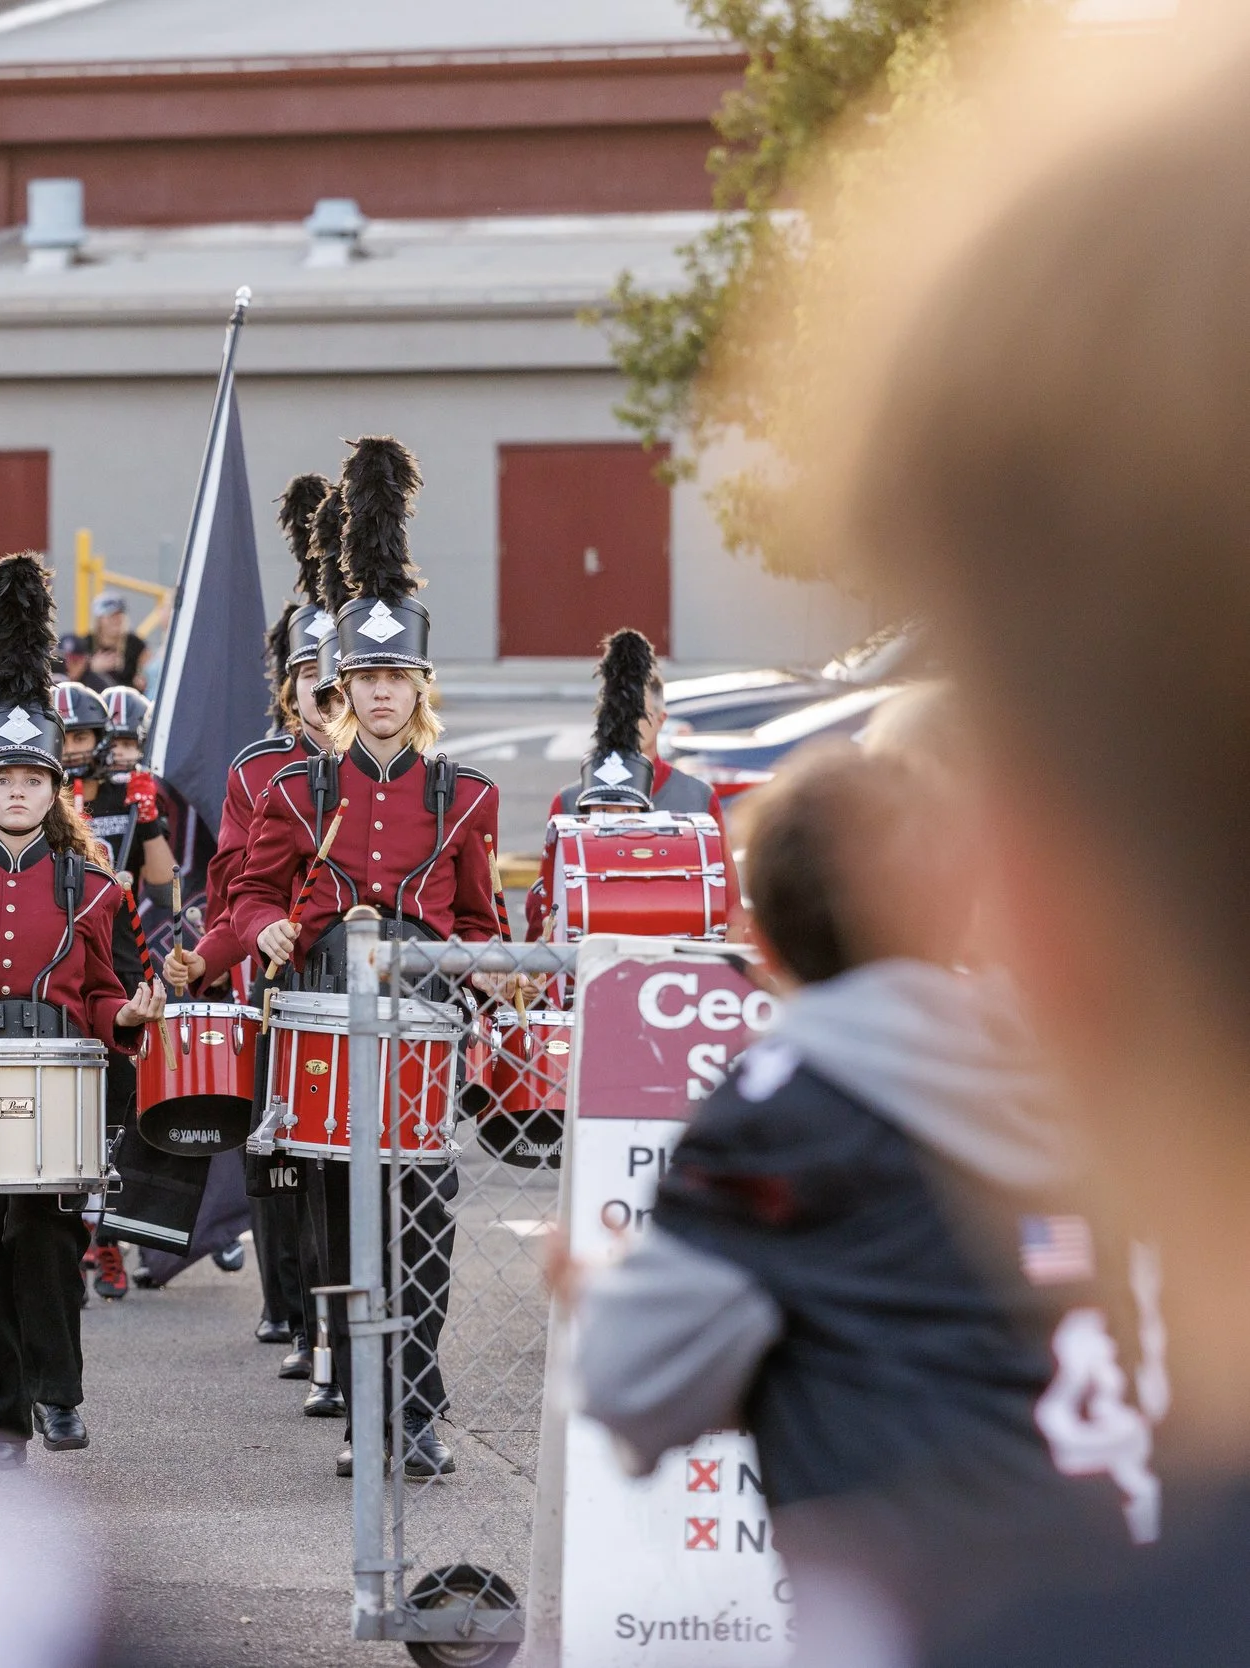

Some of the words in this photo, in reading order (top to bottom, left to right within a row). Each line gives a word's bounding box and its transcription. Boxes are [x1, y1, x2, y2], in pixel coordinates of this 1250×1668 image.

[687, 1044, 730, 1100] S
[9, 1101, 28, 1109] Pearl
[178, 1129, 221, 1142] YAMAHA
[528, 1143, 564, 1156] YAMAH
[628, 1146, 667, 1179] Pl
[737, 1463, 764, 1495] N
[735, 1519, 766, 1553] N
[615, 1613, 773, 1647] Synthetic
